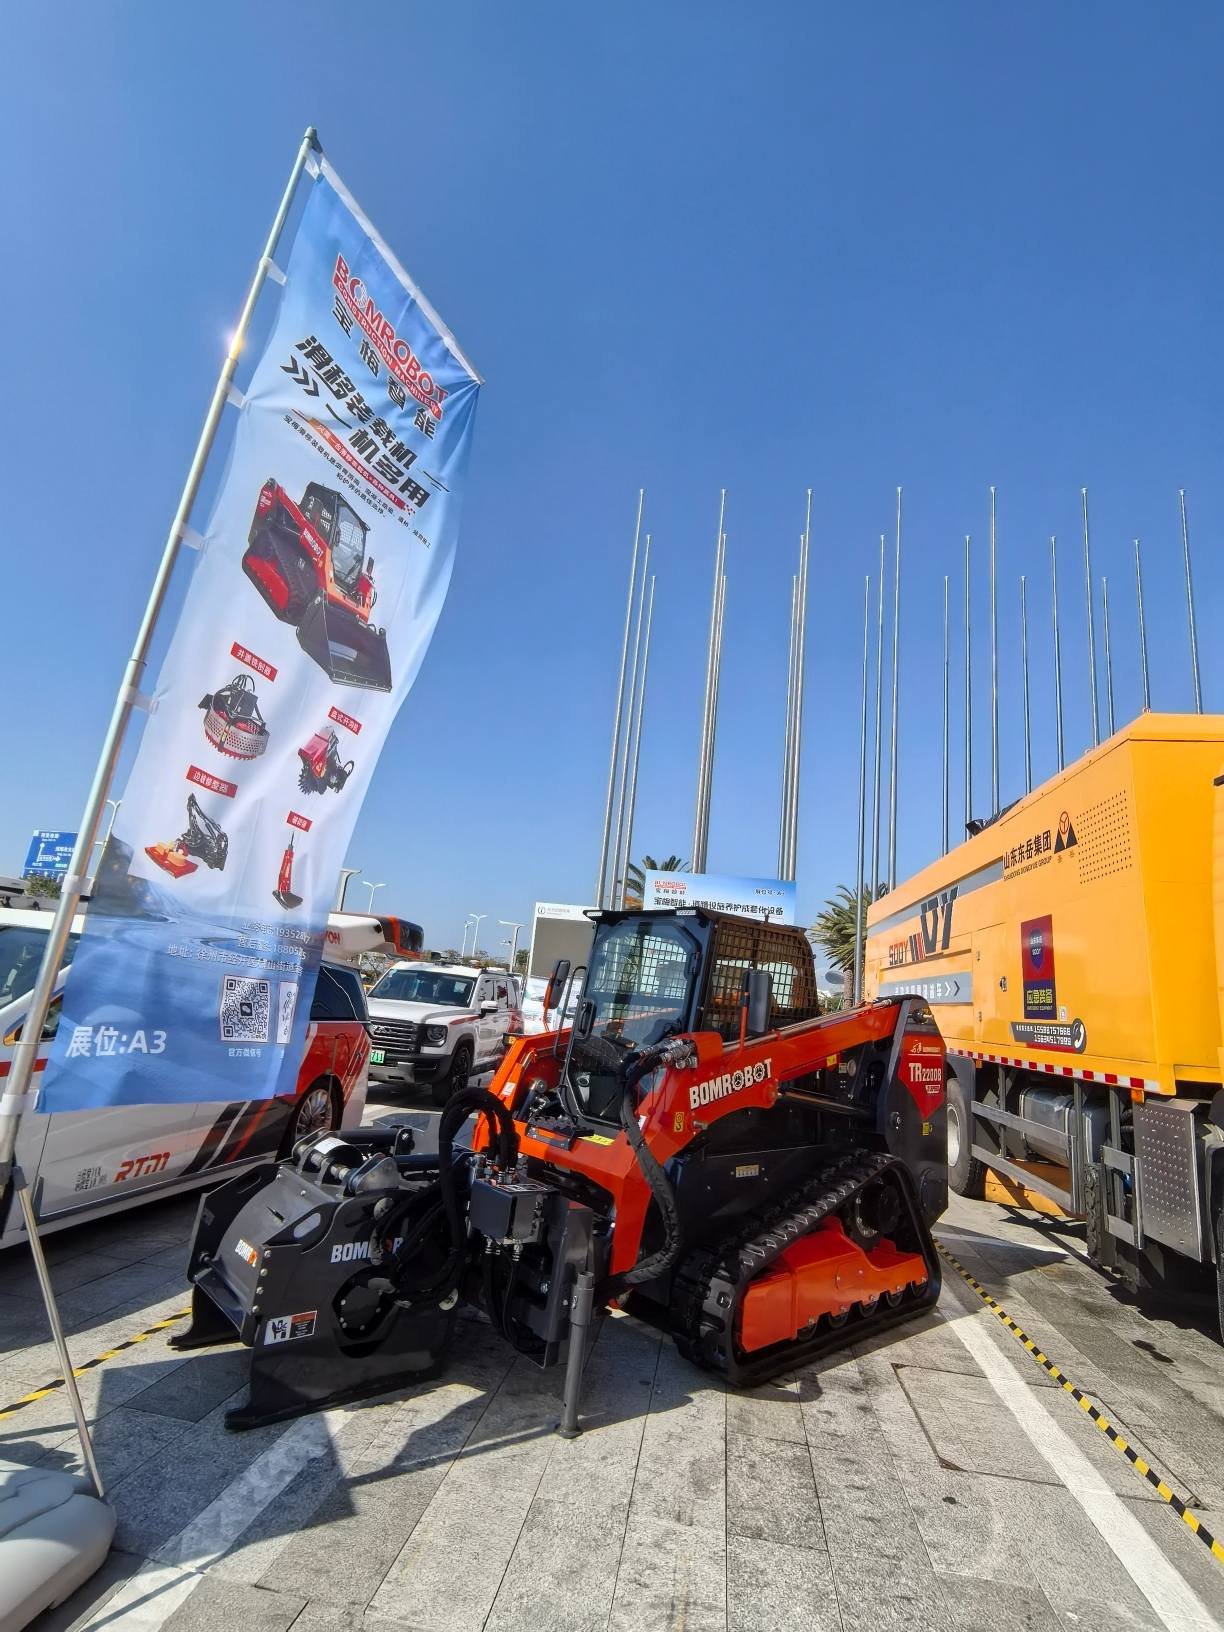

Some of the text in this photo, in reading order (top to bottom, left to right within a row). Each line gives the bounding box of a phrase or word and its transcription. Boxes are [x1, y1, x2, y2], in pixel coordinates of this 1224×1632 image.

[335, 253, 449, 404] BOMROBOT
[338, 281, 439, 414] CONSTRUCTION MACHINERY
[295, 336, 418, 470] 滑移装载机
[325, 403, 431, 508] 一机多用
[1003, 829, 1051, 870] 山东东岳集团
[65, 1026, 167, 1058] 展位:A3
[689, 1057, 772, 1110] BOMROBOT
